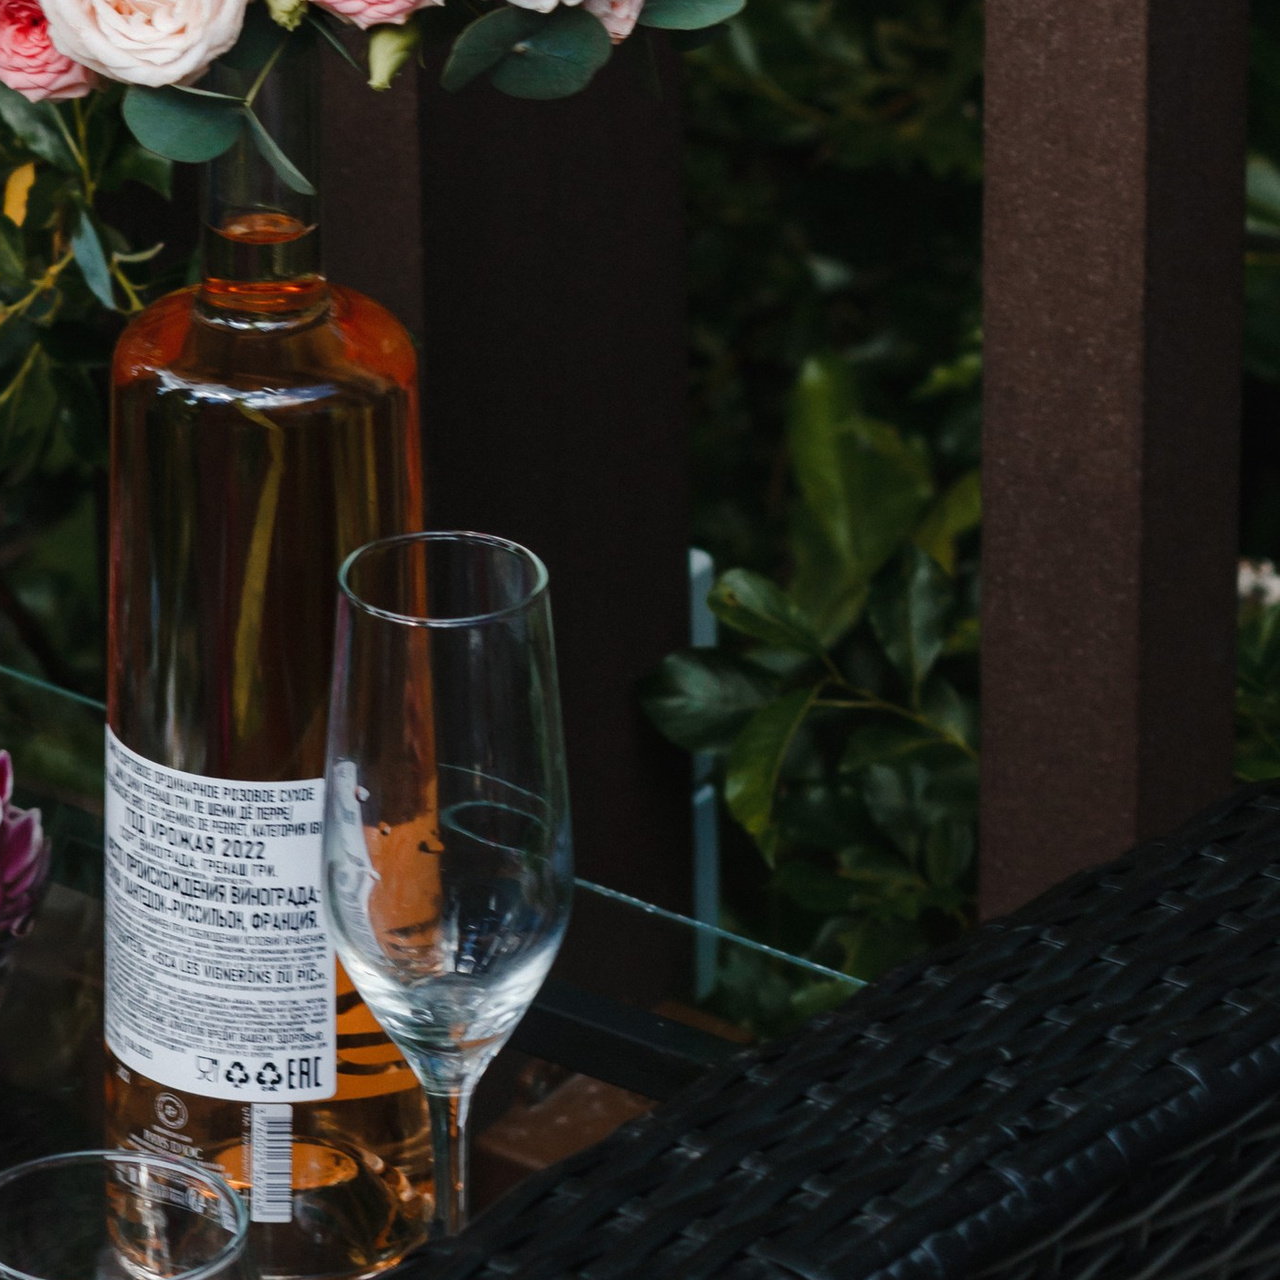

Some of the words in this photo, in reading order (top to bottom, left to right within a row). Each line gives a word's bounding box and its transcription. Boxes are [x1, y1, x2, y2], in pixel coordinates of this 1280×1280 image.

[154, 771, 220, 799] ОРДИНАРНОЕ
[223, 787, 276, 802] РОЗОВОЕ
[280, 787, 315, 802] СУХОЕ
[175, 795, 188, 810] ГРИ
[208, 801, 236, 818] ШЕМИ
[124, 806, 146, 835] ГОД
[150, 822, 216, 856] УРОЖАЯ
[222, 838, 266, 859] 2022
[160, 807, 195, 829] CHEMINS
[198, 817, 209, 832] DE
[252, 823, 307, 838] КАТЕГОРИЯ
[139, 838, 200, 869] ВИНОГРАДА:
[202, 858, 247, 877] ГРЕНАШ
[251, 863, 278, 877] ГРИ.
[126, 853, 226, 903] ПРОИСХОЖДЕНИЯ
[231, 885, 321, 908] ВИНОГРАДА:
[251, 910, 320, 933] ФРАНЦИЯ.
[180, 959, 200, 976] LES
[204, 965, 272, 983] VIGNERONS
[277, 969, 293, 983] DU
[288, 1056, 322, 1089] EAC
